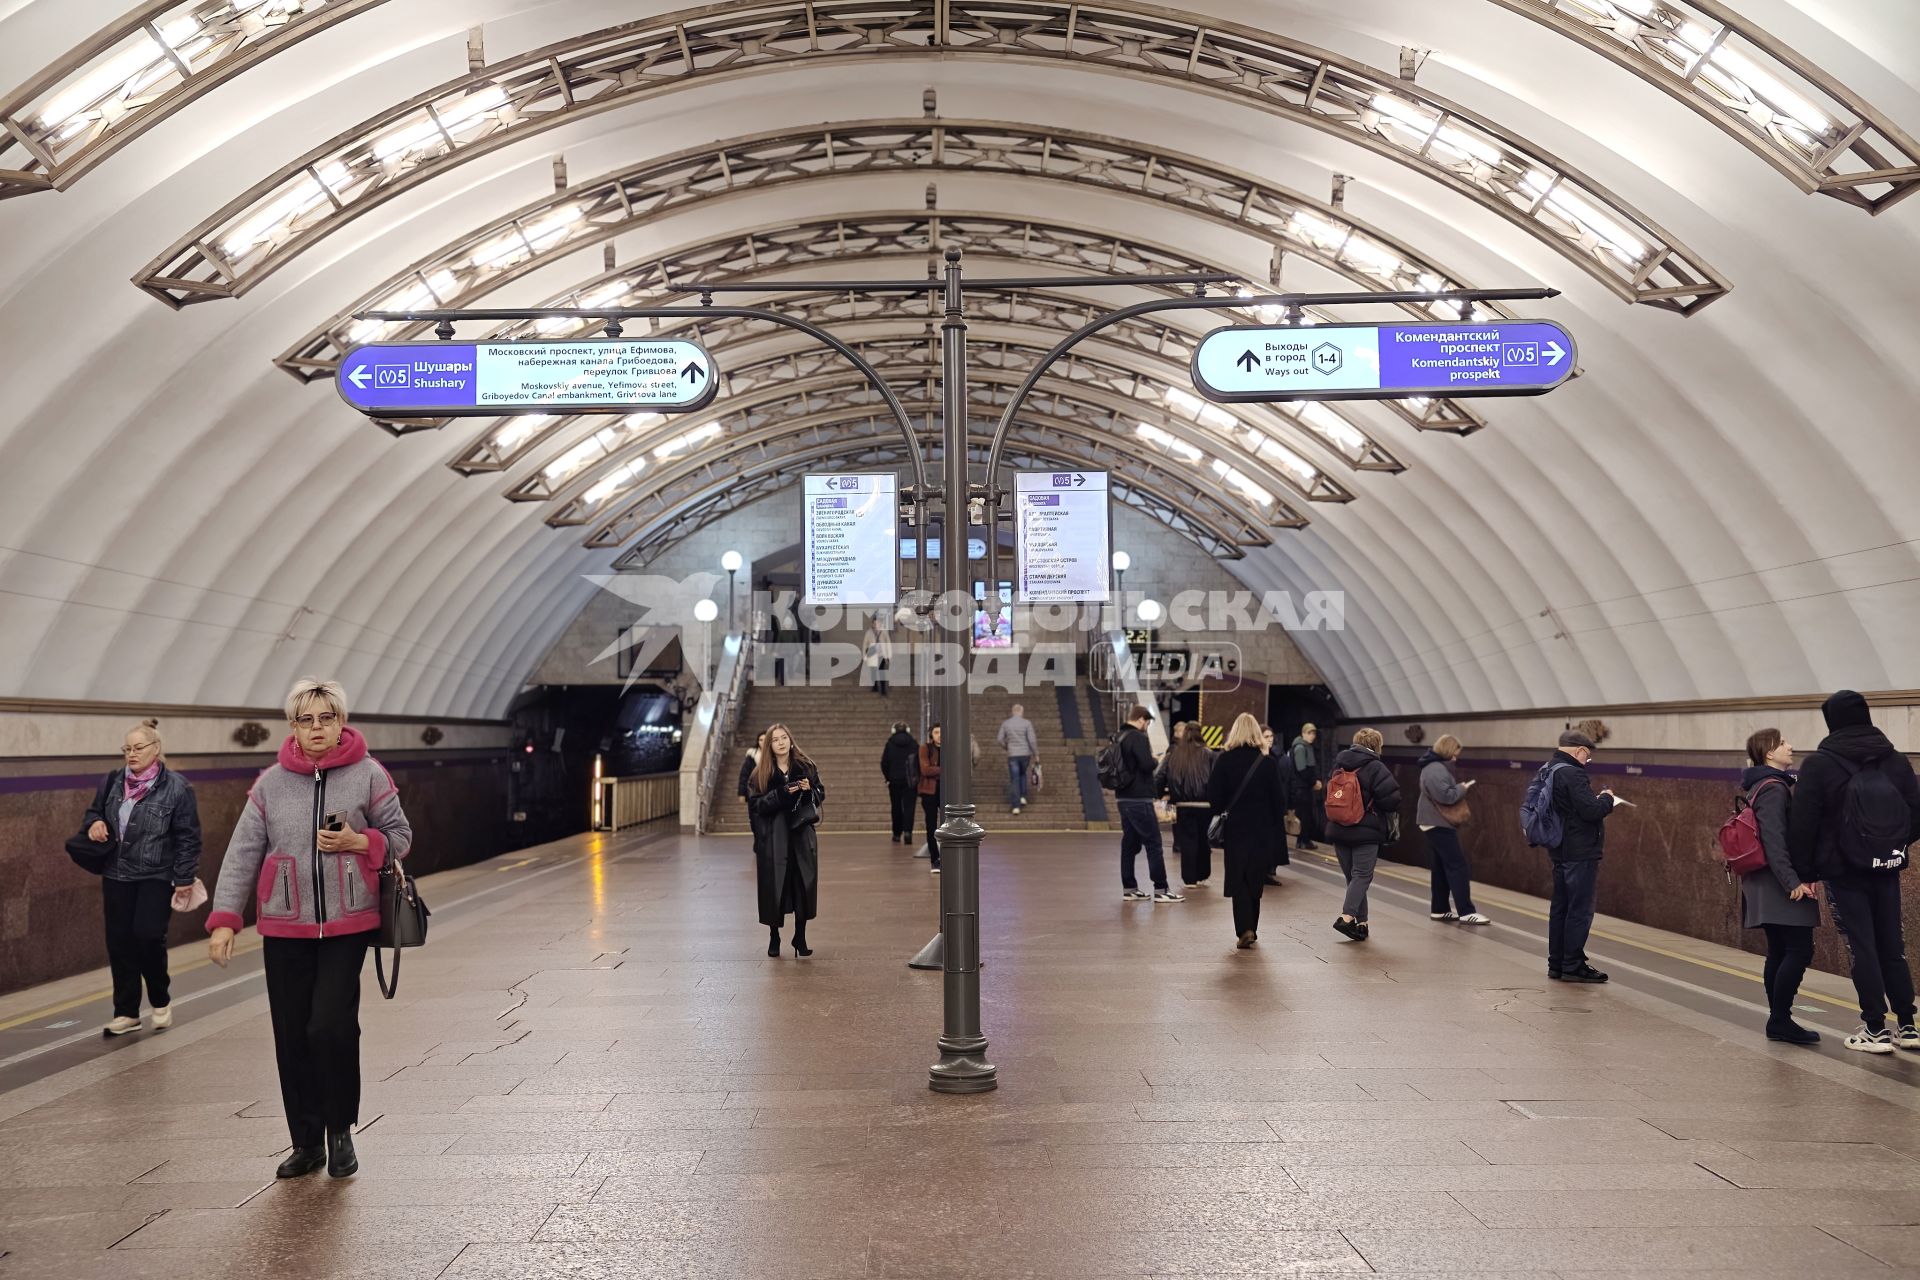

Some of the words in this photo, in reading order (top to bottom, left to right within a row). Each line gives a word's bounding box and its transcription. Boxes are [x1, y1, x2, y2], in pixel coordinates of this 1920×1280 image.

[1395, 330, 1499, 343] Комендантский
[488, 347, 547, 356] Московский
[549, 347, 596, 357] проспект,
[598, 347, 627, 356] улица
[630, 346, 677, 355] Ефимова,
[1265, 342, 1308, 351] Выходы
[1440, 343, 1500, 355] проспект
[518, 357, 577, 366] набережная
[617, 357, 677, 366] Грибоедова,
[1275, 354, 1306, 363] город
[1318, 353, 1337, 364] 1-4
[1411, 356, 1500, 369] Komendantskiy
[414, 361, 473, 375] Шушары
[583, 368, 628, 377] переулок
[631, 367, 677, 376] Гривцова
[1265, 368, 1290, 377] Ways
[1450, 369, 1501, 382] prospekt
[414, 378, 466, 390] Shushary
[521, 382, 570, 391] Moskovskiy
[572, 382, 605, 390] avenue,
[608, 381, 648, 389] Yefimova
[650, 381, 677, 389] street,
[481, 392, 529, 402] Griboyedov
[531, 392, 555, 400] Canal
[557, 391, 614, 400] embankment,
[616, 390, 657, 399] Grivtsova
[659, 390, 677, 398] lane
